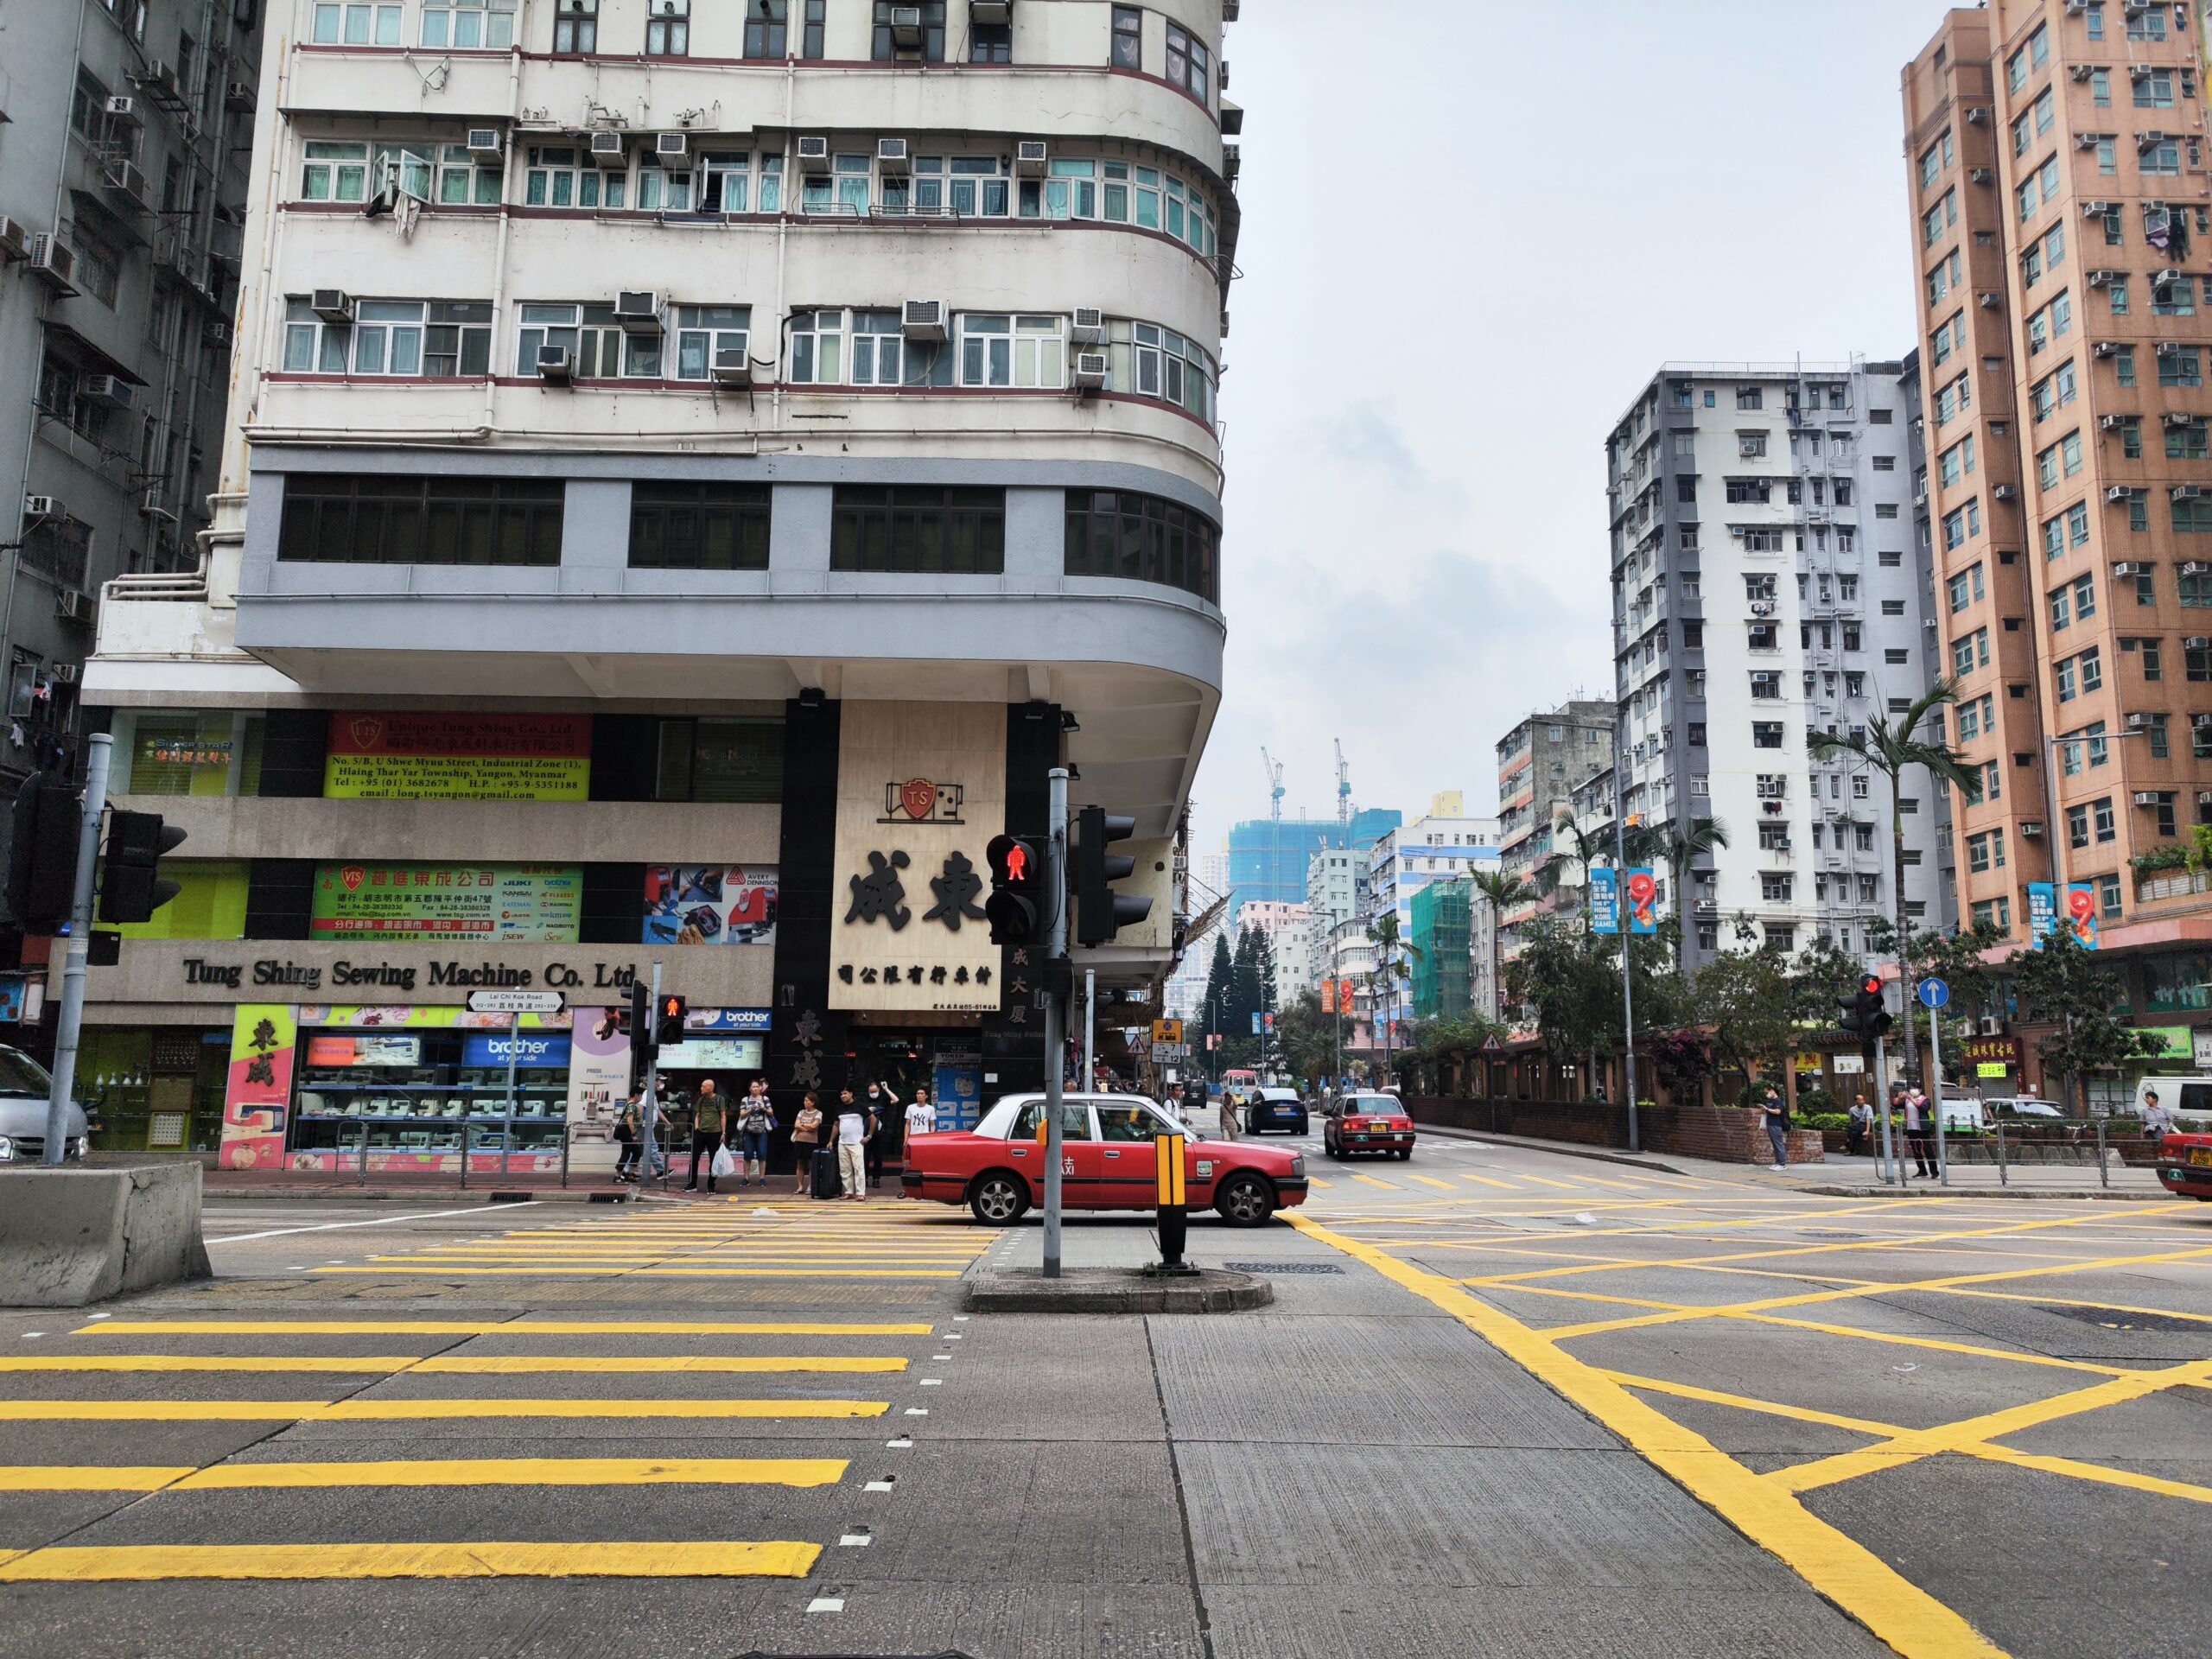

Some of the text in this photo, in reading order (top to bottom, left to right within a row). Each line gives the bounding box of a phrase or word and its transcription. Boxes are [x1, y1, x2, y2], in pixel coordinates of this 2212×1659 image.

[355, 722, 377, 736] UTS
[442, 721, 474, 736] Tung
[332, 757, 349, 766] No.
[376, 758, 385, 766] U
[386, 758, 413, 767] Shwe
[481, 759, 533, 769] Industrial
[536, 760, 562, 769] Zone
[376, 766, 399, 777] Thar
[402, 767, 417, 777] Yar
[421, 767, 474, 779] Township,
[476, 768, 516, 779] Yangon,
[518, 769, 568, 780] Myanmar
[334, 778, 349, 787] Tel
[359, 778, 378, 787] +95
[359, 788, 389, 797] email
[908, 791, 928, 806] TS
[345, 870, 362, 882] VTS
[183, 957, 242, 987] Tung
[252, 959, 321, 988] Shing
[331, 959, 416, 989] Sewing
[428, 960, 531, 987] Machine
[543, 962, 584, 987] Co.
[1007, 948, 1028, 1024] 成大廈
[727, 1011, 769, 1023] brother
[487, 1039, 550, 1054] brother
[1061, 1165, 1075, 1176] AXI
